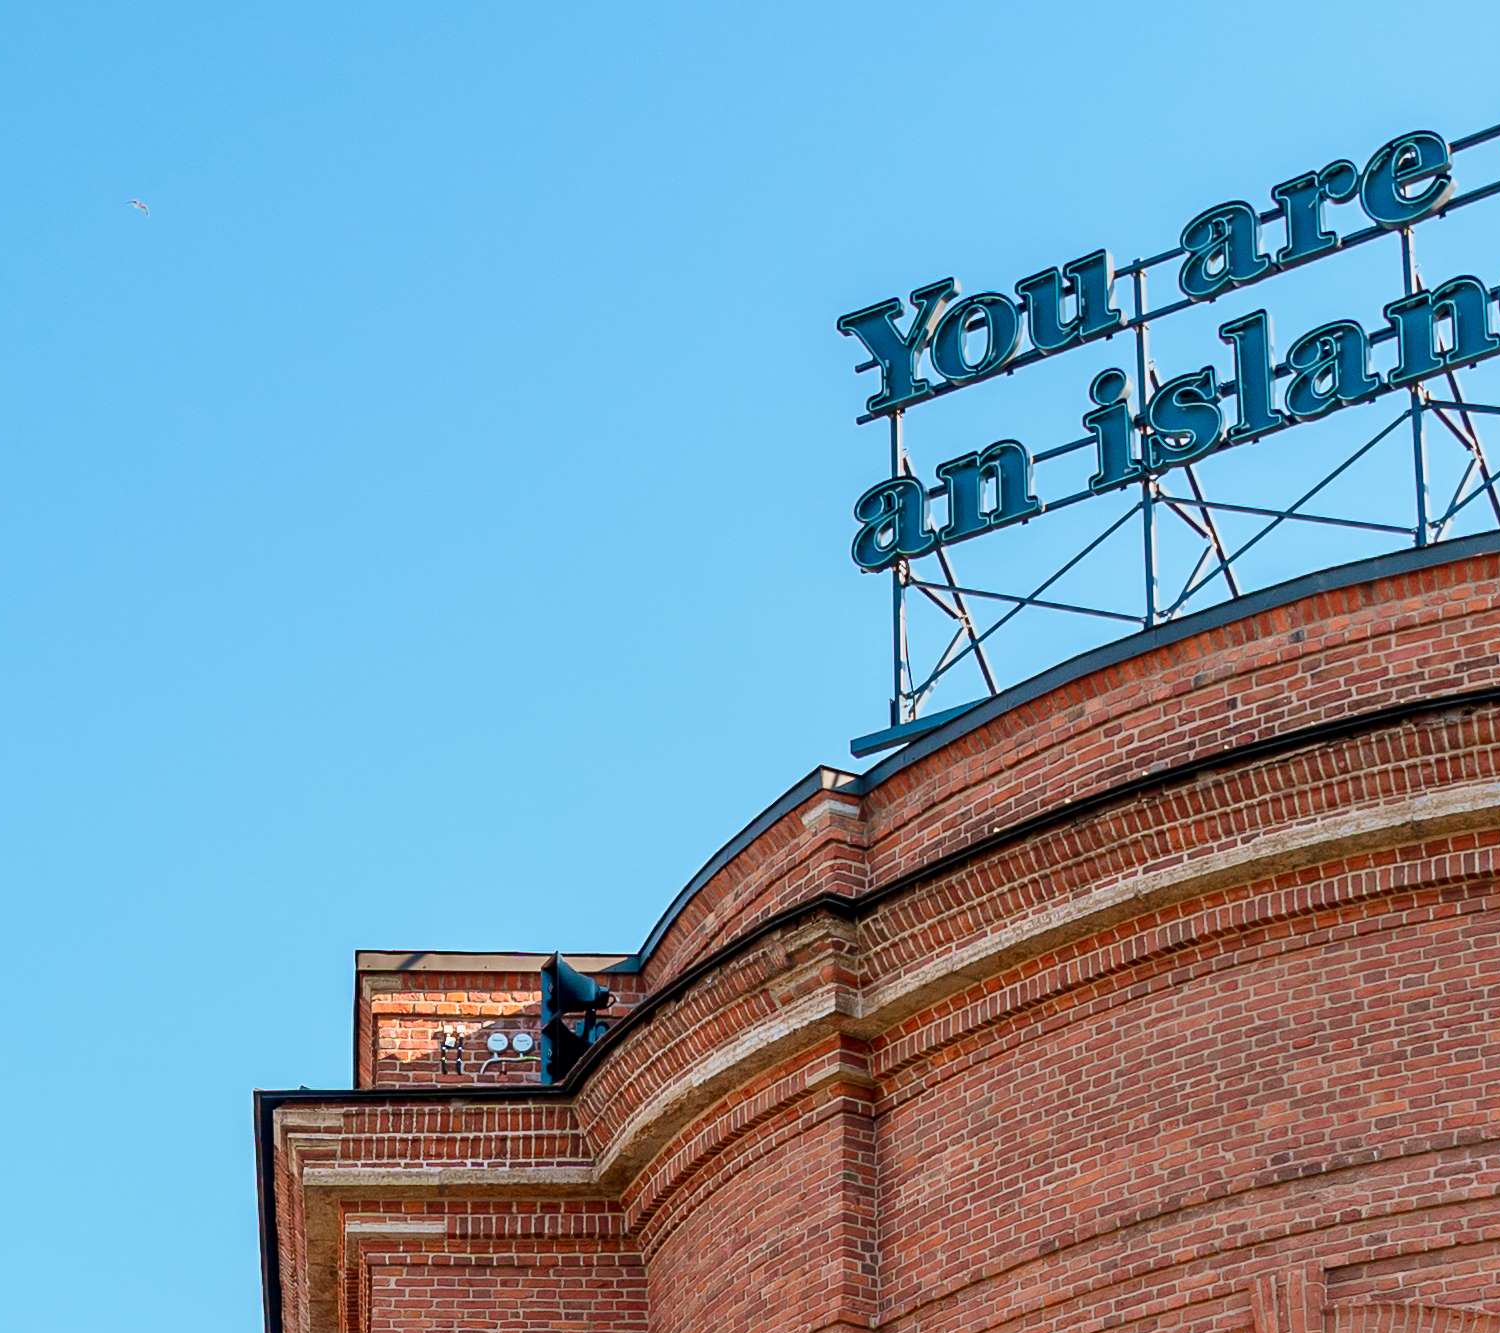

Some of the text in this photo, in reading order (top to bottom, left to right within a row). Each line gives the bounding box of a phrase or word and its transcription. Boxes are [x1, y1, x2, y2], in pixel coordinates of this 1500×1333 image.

[837, 249, 1125, 415] You
[1178, 130, 1453, 301] are
[851, 438, 1042, 572] an
